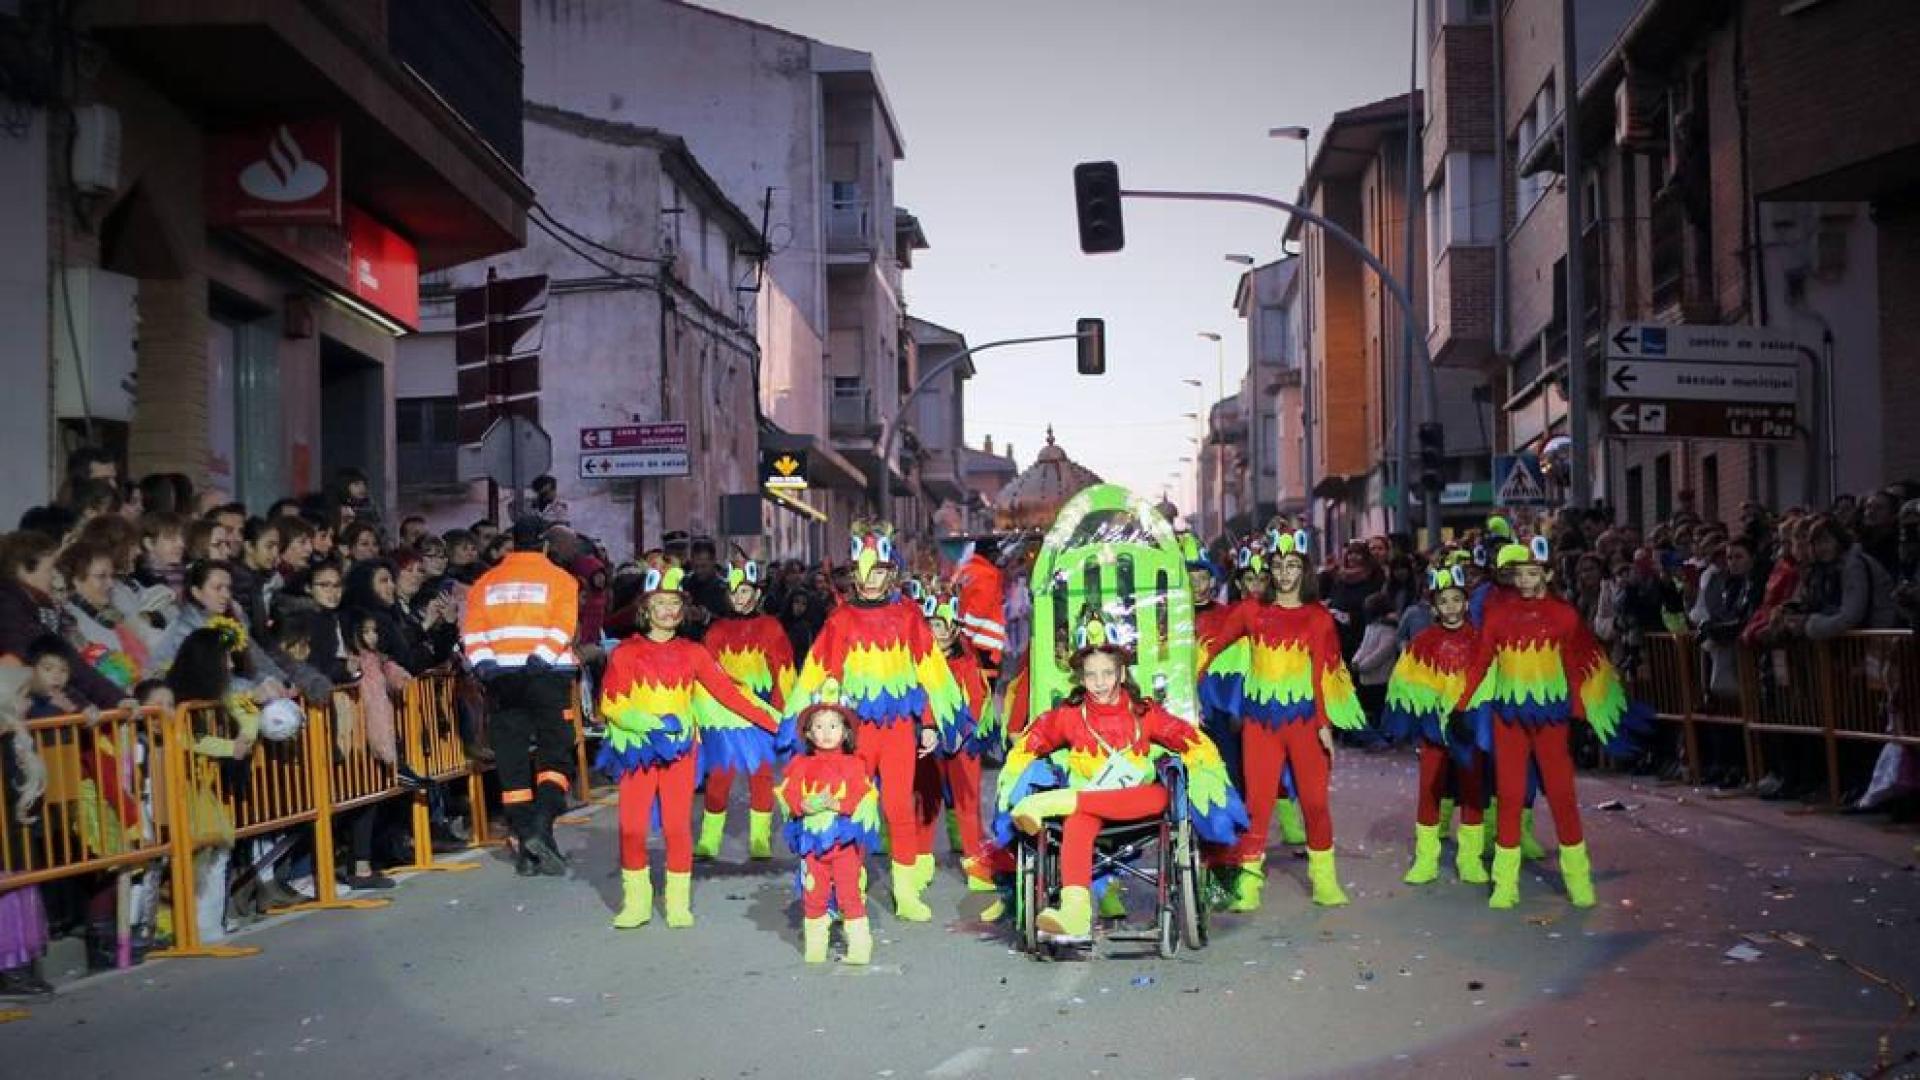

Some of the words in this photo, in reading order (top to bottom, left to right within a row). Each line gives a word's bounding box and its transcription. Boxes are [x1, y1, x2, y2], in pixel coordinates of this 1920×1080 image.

[1737, 338, 1753, 348] de
[1731, 375, 1793, 389] municipal
[1762, 419, 1793, 436] Paz
